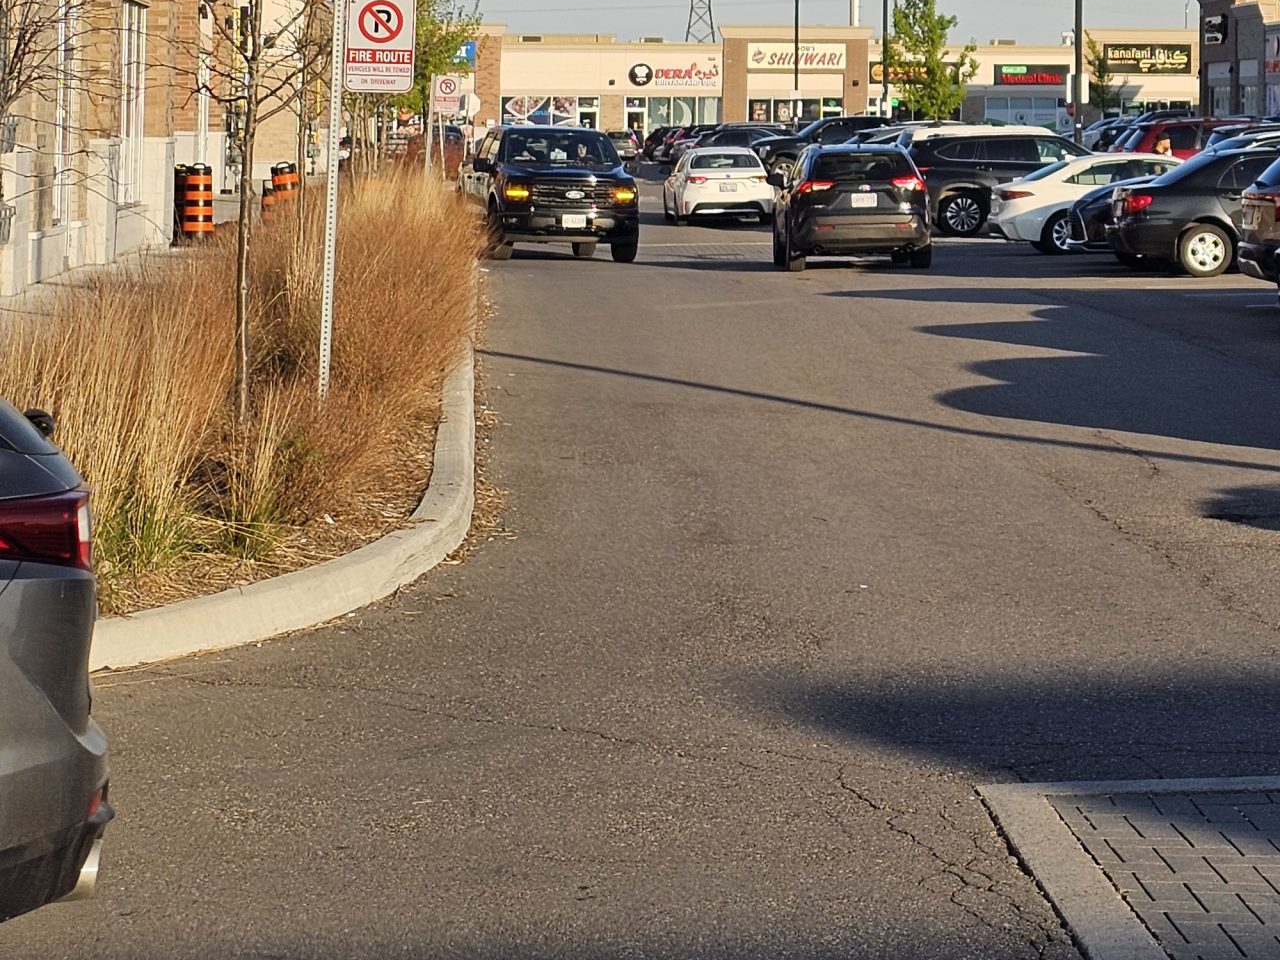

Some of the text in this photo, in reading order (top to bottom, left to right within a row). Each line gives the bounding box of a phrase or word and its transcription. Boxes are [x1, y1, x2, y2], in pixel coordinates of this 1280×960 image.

[349, 50, 411, 63] FIRE ROUTE
[1107, 46, 1151, 59] kanafani
[1002, 72, 1062, 84] Medical Clinic
